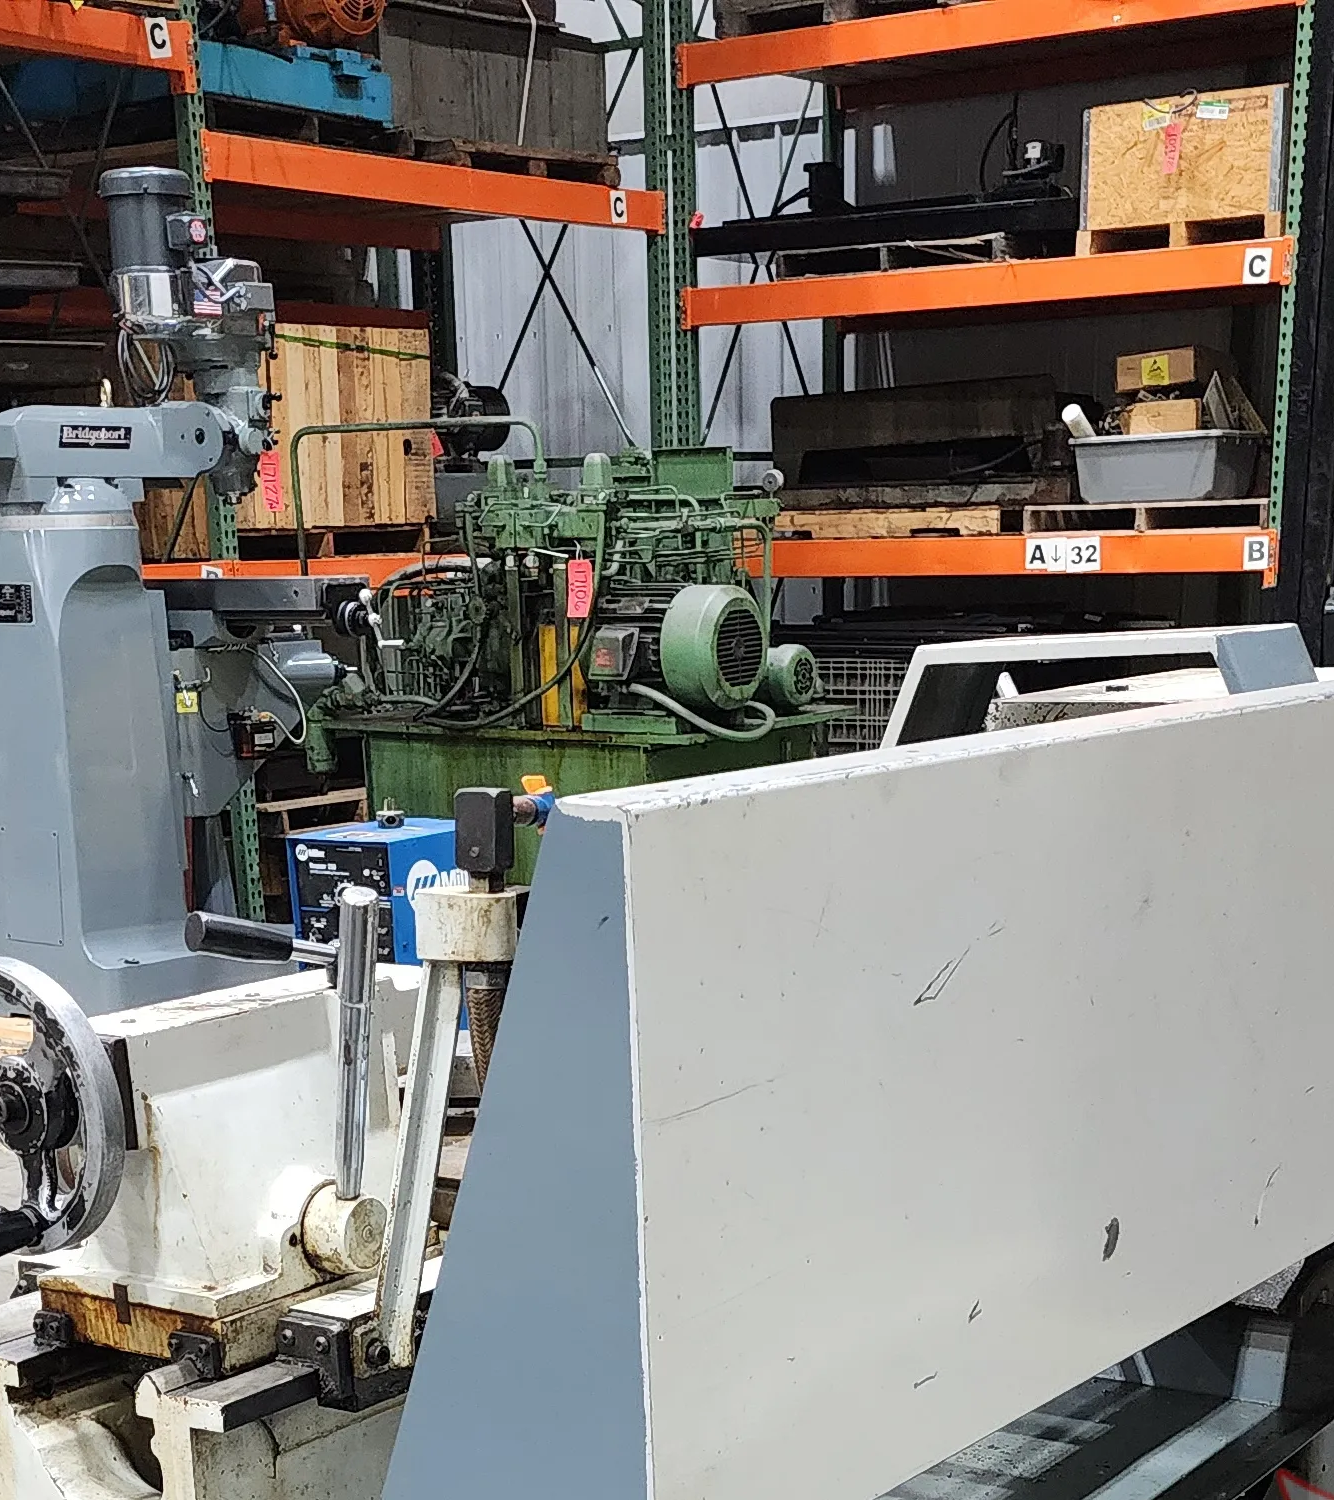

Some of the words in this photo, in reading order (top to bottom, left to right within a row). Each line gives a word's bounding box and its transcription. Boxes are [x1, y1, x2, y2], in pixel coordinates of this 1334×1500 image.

[150, 22, 167, 50] C
[613, 196, 624, 218] C
[1248, 254, 1267, 278] C
[62, 426, 126, 447] Bridgeport
[1029, 544, 1047, 565] A
[1070, 544, 1098, 565] 32
[1247, 540, 1265, 562] B
